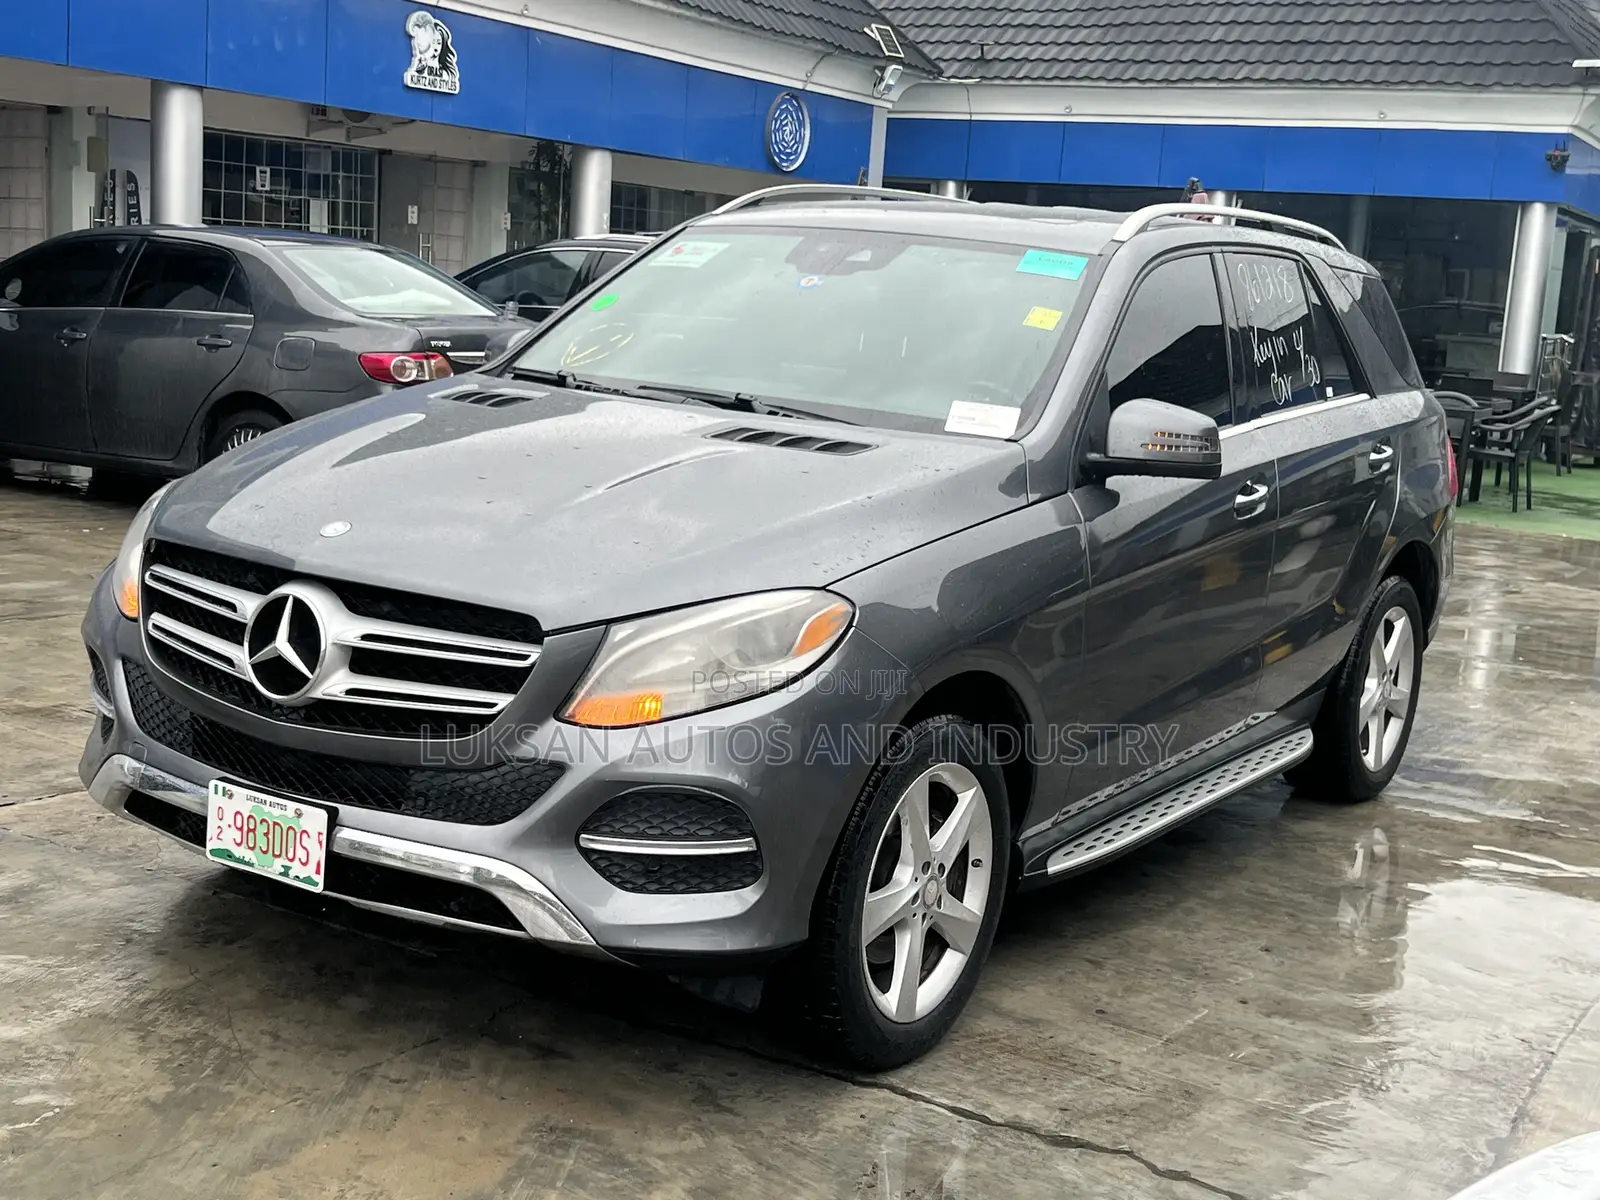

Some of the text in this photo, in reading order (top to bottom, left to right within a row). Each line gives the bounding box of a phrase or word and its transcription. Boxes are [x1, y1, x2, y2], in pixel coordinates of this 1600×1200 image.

[428, 77, 438, 89] AND
[439, 79, 457, 92] STYLES
[269, 800, 288, 812] AUTOS
